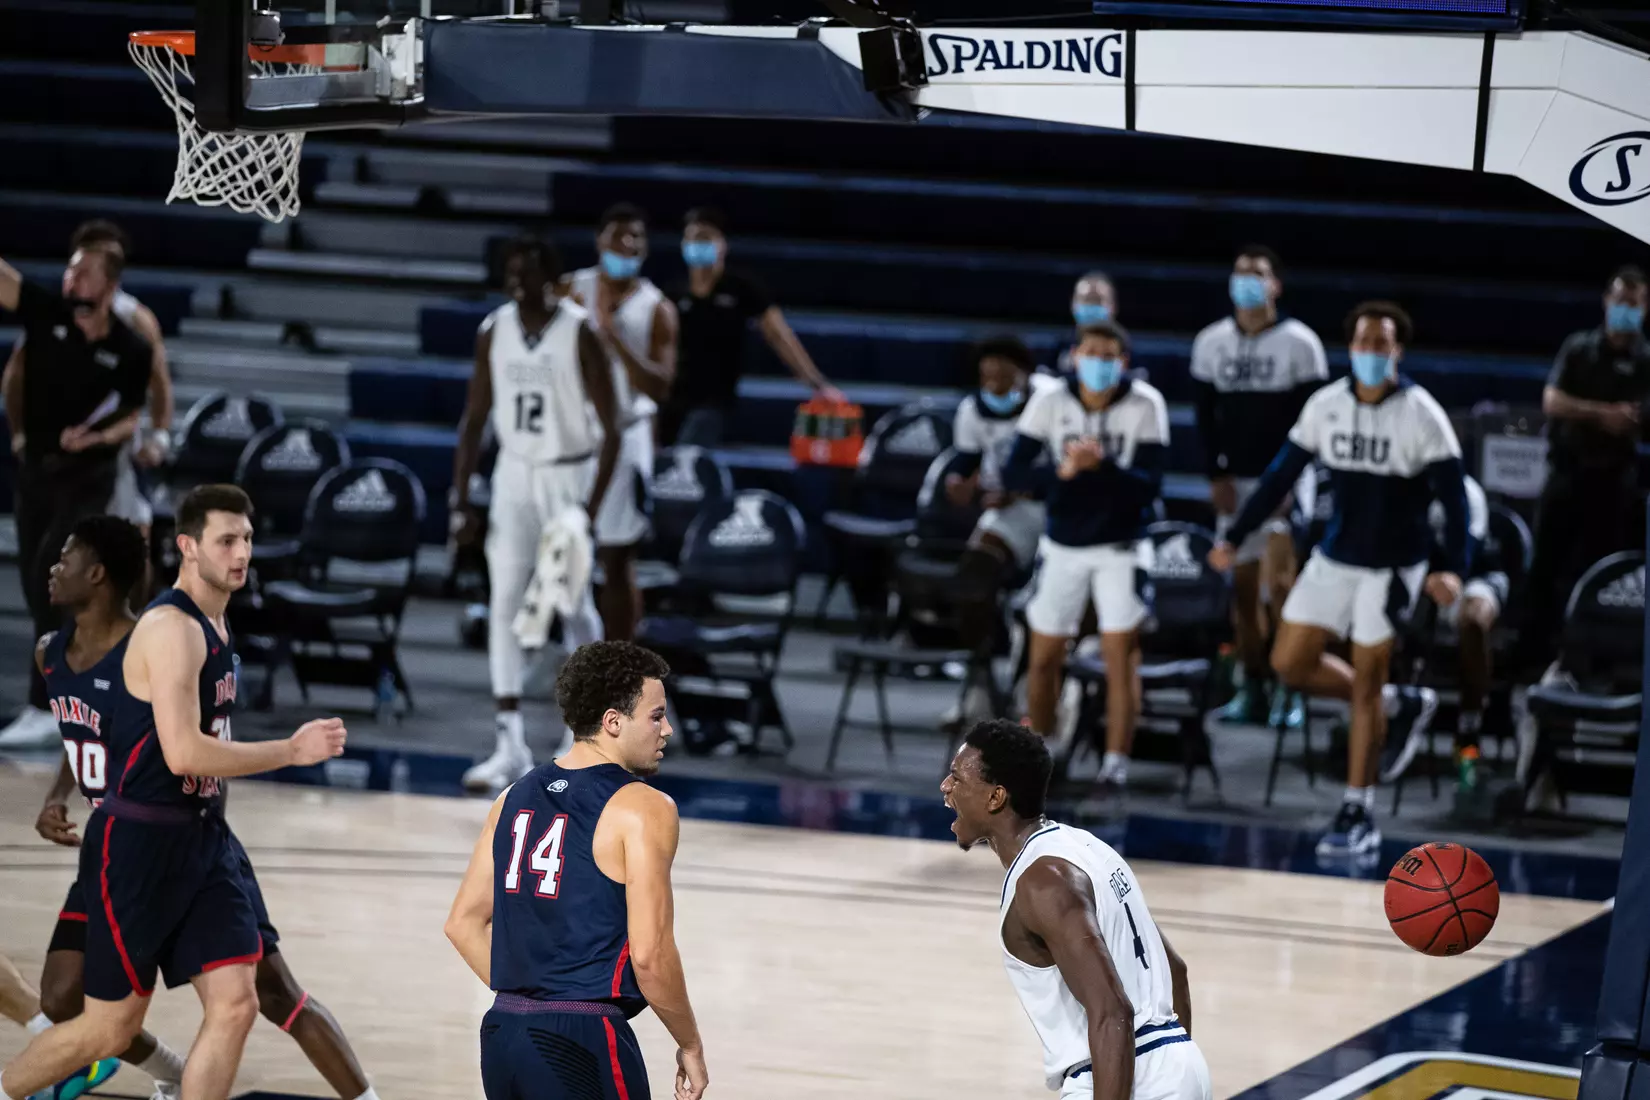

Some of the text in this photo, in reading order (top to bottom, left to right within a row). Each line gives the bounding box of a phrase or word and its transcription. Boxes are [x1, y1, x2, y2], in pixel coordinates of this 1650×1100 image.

[927, 33, 1122, 79] SPALDING
[1605, 144, 1642, 192] S
[513, 390, 544, 434] 12
[1330, 433, 1391, 465] CBU
[48, 695, 101, 737] DIXIE
[505, 809, 569, 899] 14
